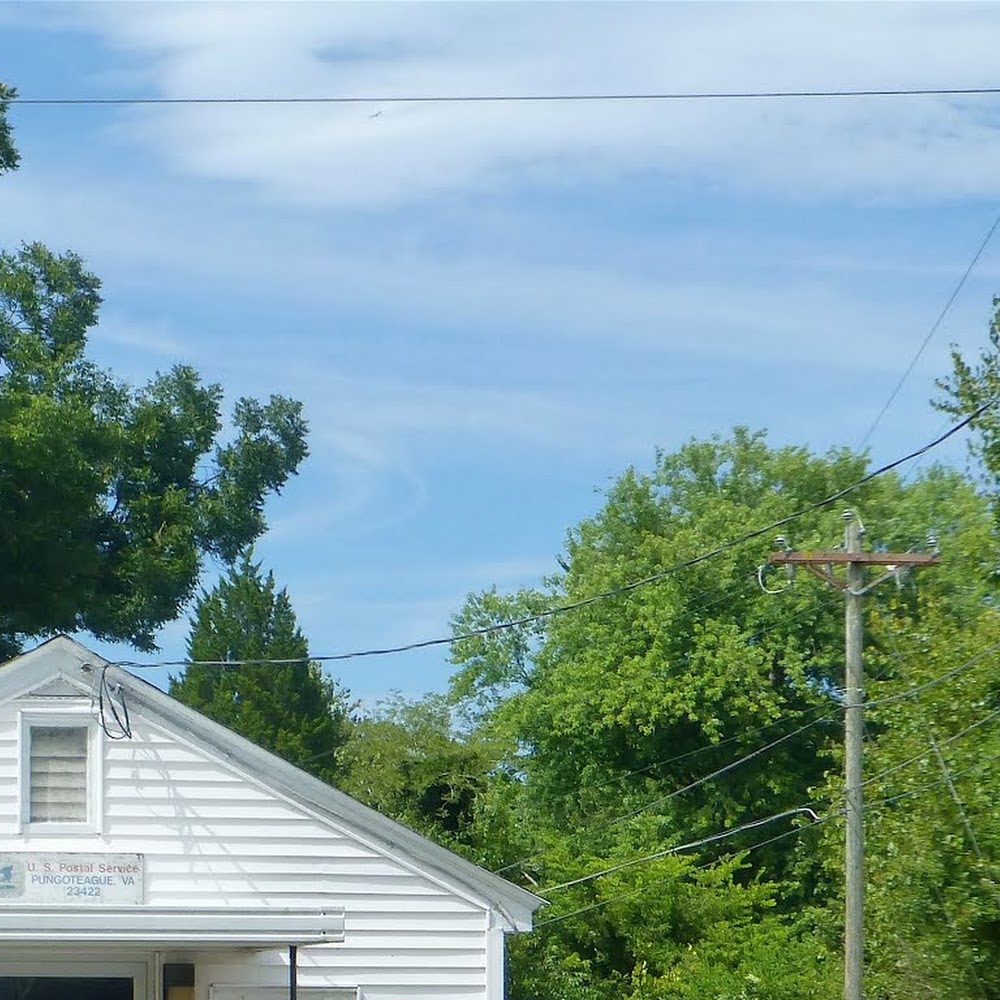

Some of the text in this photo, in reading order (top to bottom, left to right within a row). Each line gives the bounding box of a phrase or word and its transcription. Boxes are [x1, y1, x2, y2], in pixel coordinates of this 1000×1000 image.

[59, 864, 94, 873] Postal
[98, 864, 139, 873] Service
[122, 876, 135, 886] VA
[66, 886, 101, 897] 23422
